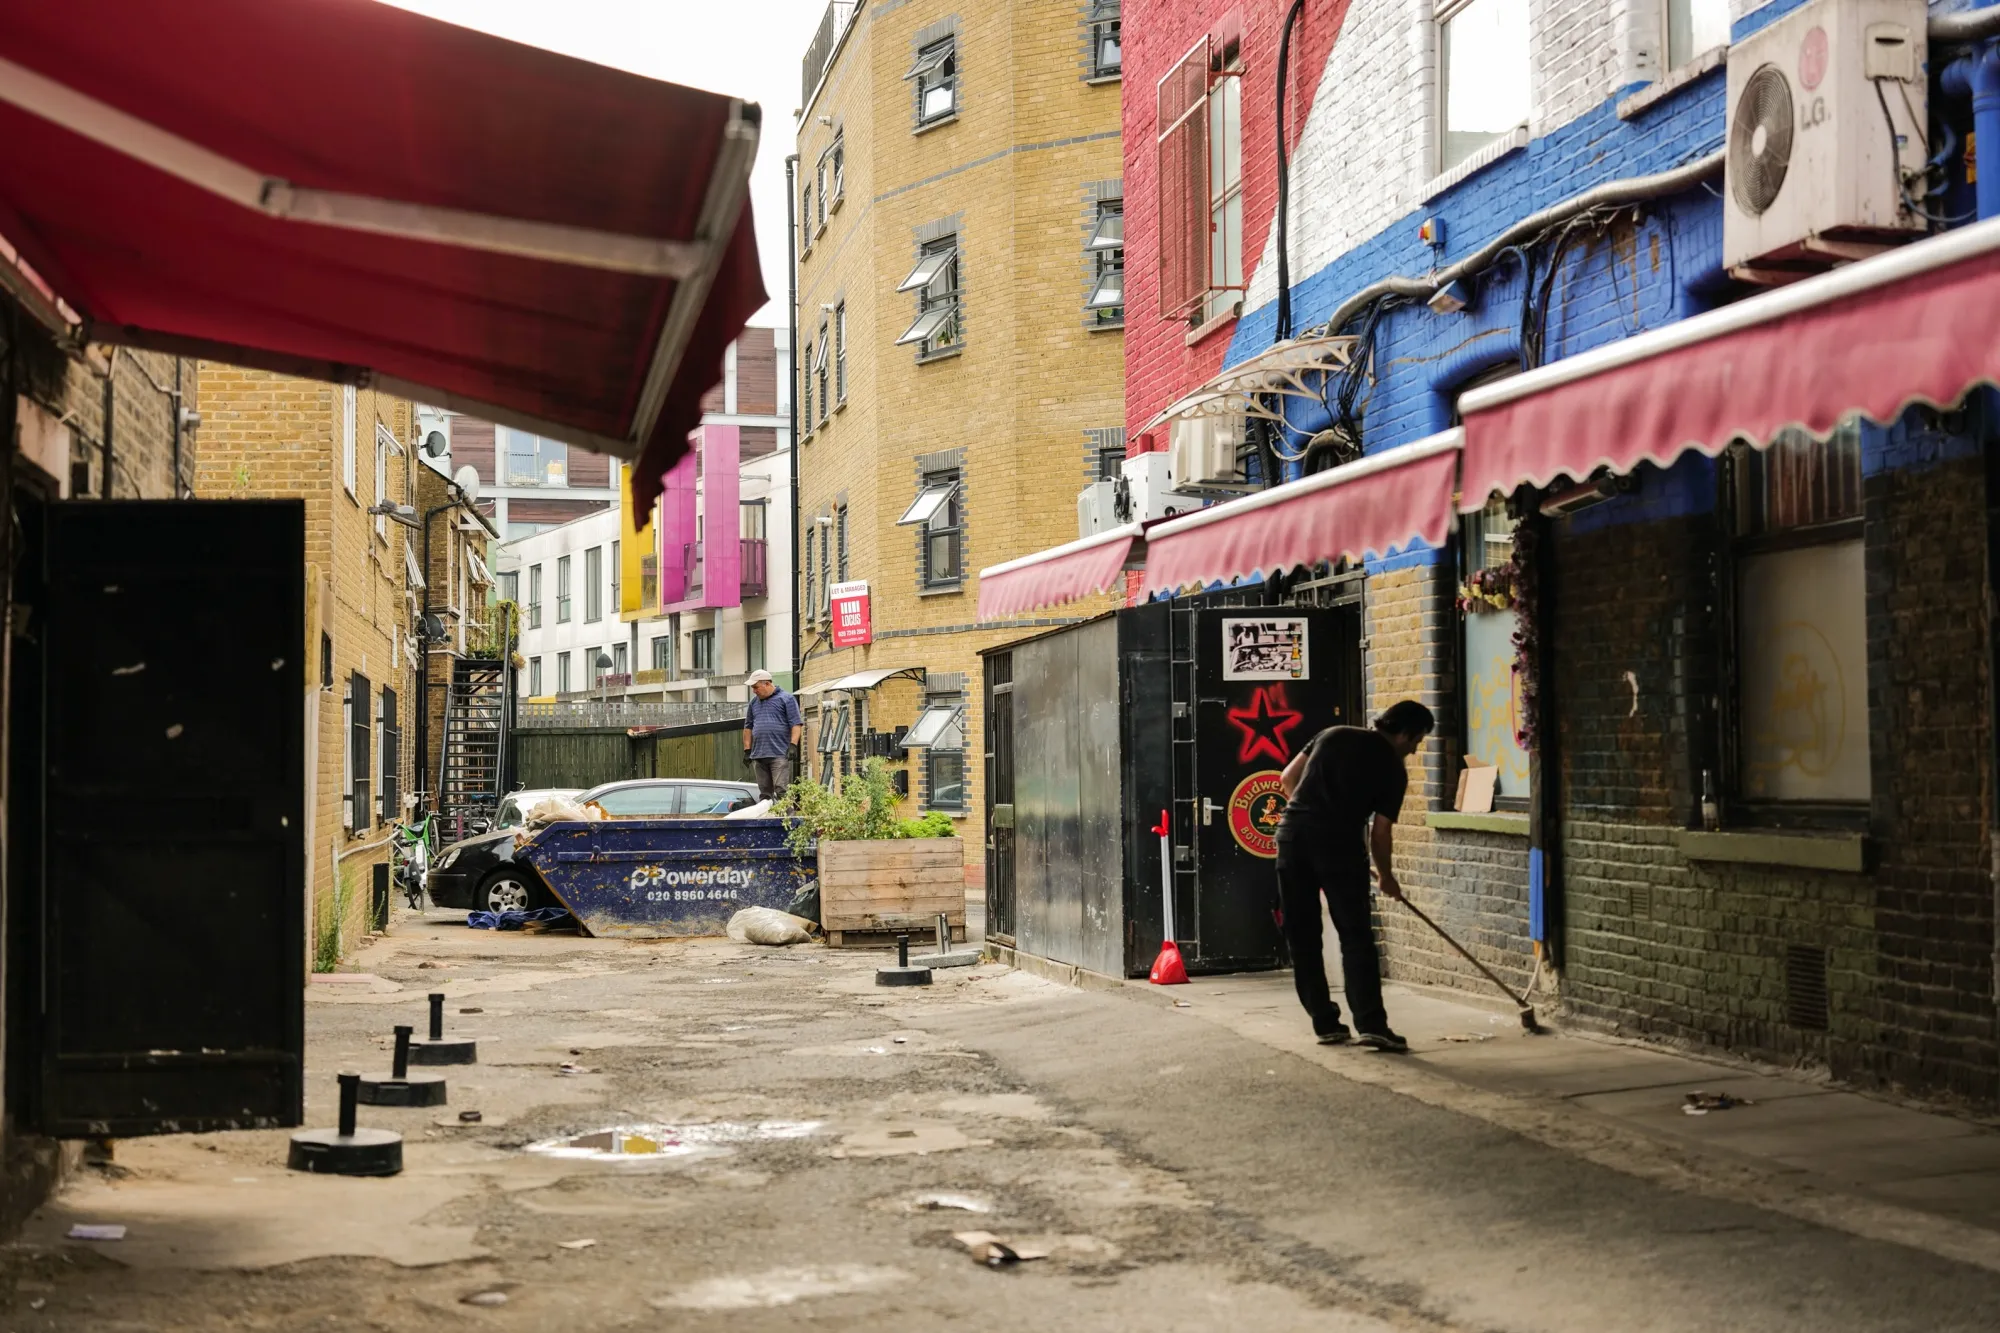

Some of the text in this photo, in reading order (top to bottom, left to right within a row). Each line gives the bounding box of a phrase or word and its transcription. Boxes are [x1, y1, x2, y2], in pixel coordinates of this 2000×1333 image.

[1801, 96, 1824, 132] LG
[845, 584, 866, 593] MANAGED
[841, 614, 861, 627] LOCUS
[651, 865, 752, 888] Powerday
[647, 889, 738, 901] 020 8960 4646
